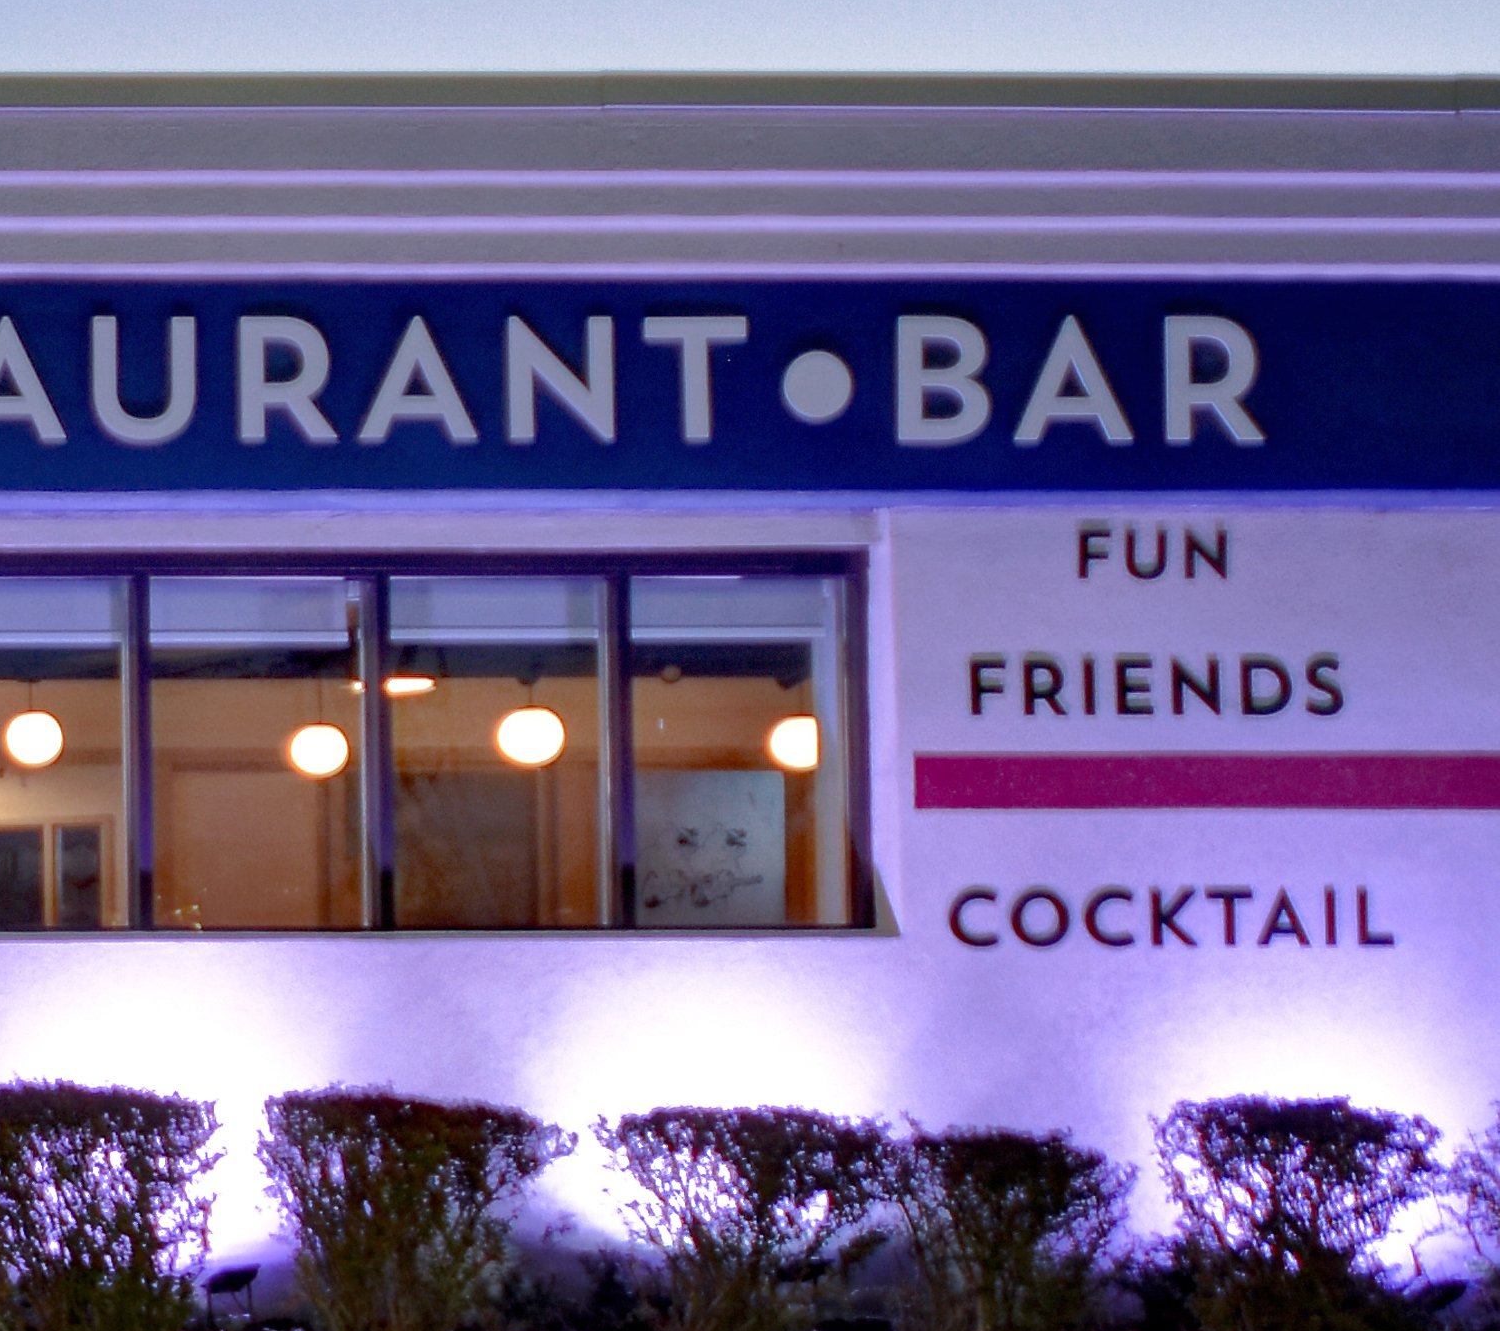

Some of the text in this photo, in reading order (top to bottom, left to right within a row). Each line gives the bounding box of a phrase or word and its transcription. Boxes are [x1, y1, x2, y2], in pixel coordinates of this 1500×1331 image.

[896, 314, 1265, 444] BAR
[1074, 519, 1231, 582] FUN
[965, 651, 1347, 718] FRIENDS
[947, 886, 1397, 949] COCKTAIL
